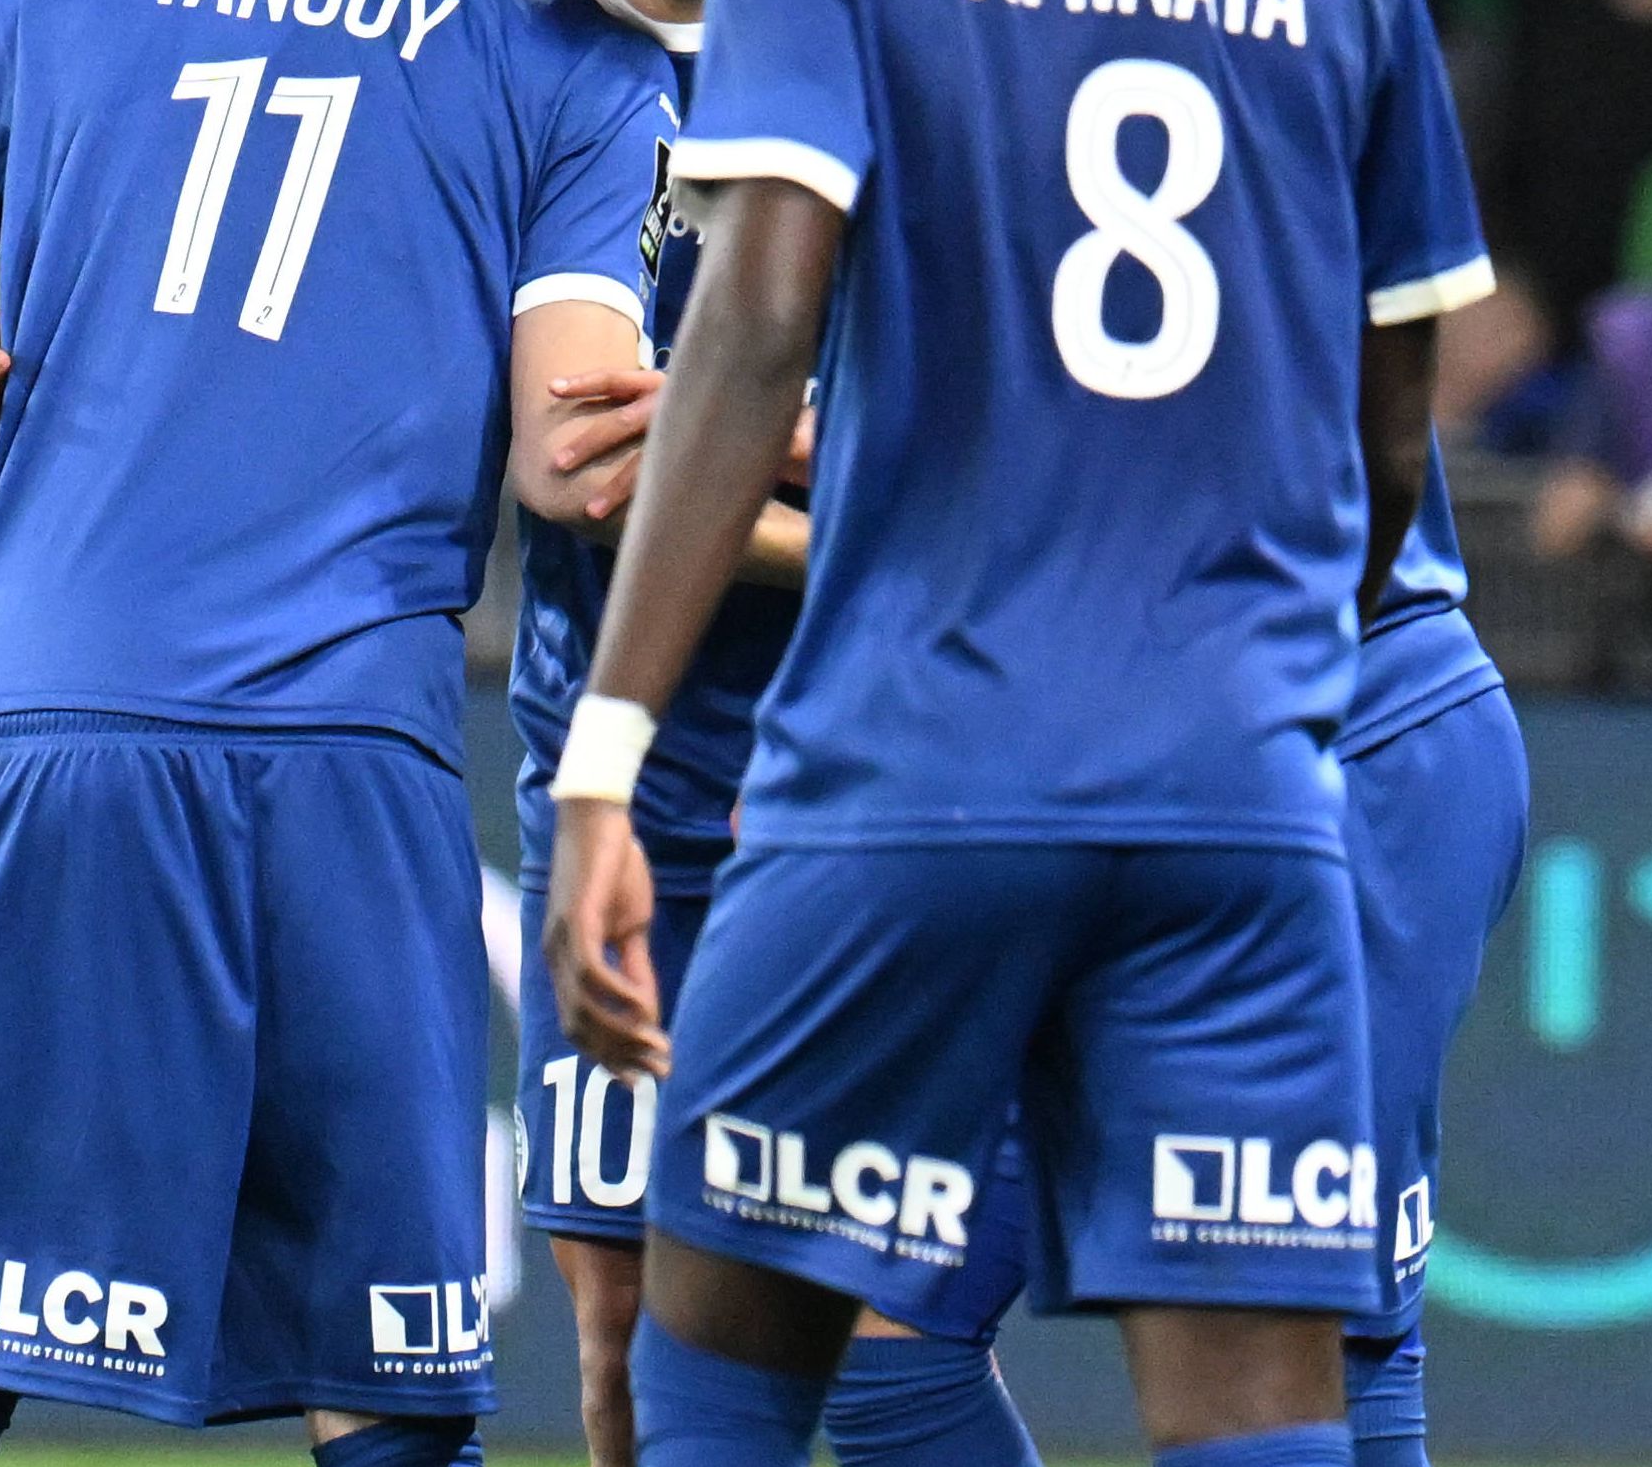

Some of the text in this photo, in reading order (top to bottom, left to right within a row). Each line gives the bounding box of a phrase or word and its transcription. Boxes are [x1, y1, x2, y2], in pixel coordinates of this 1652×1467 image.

[153, 55, 360, 342] 11
[1050, 57, 1224, 400] 8
[543, 1053, 658, 1208] 10
[776, 1132, 975, 1247] LCR
